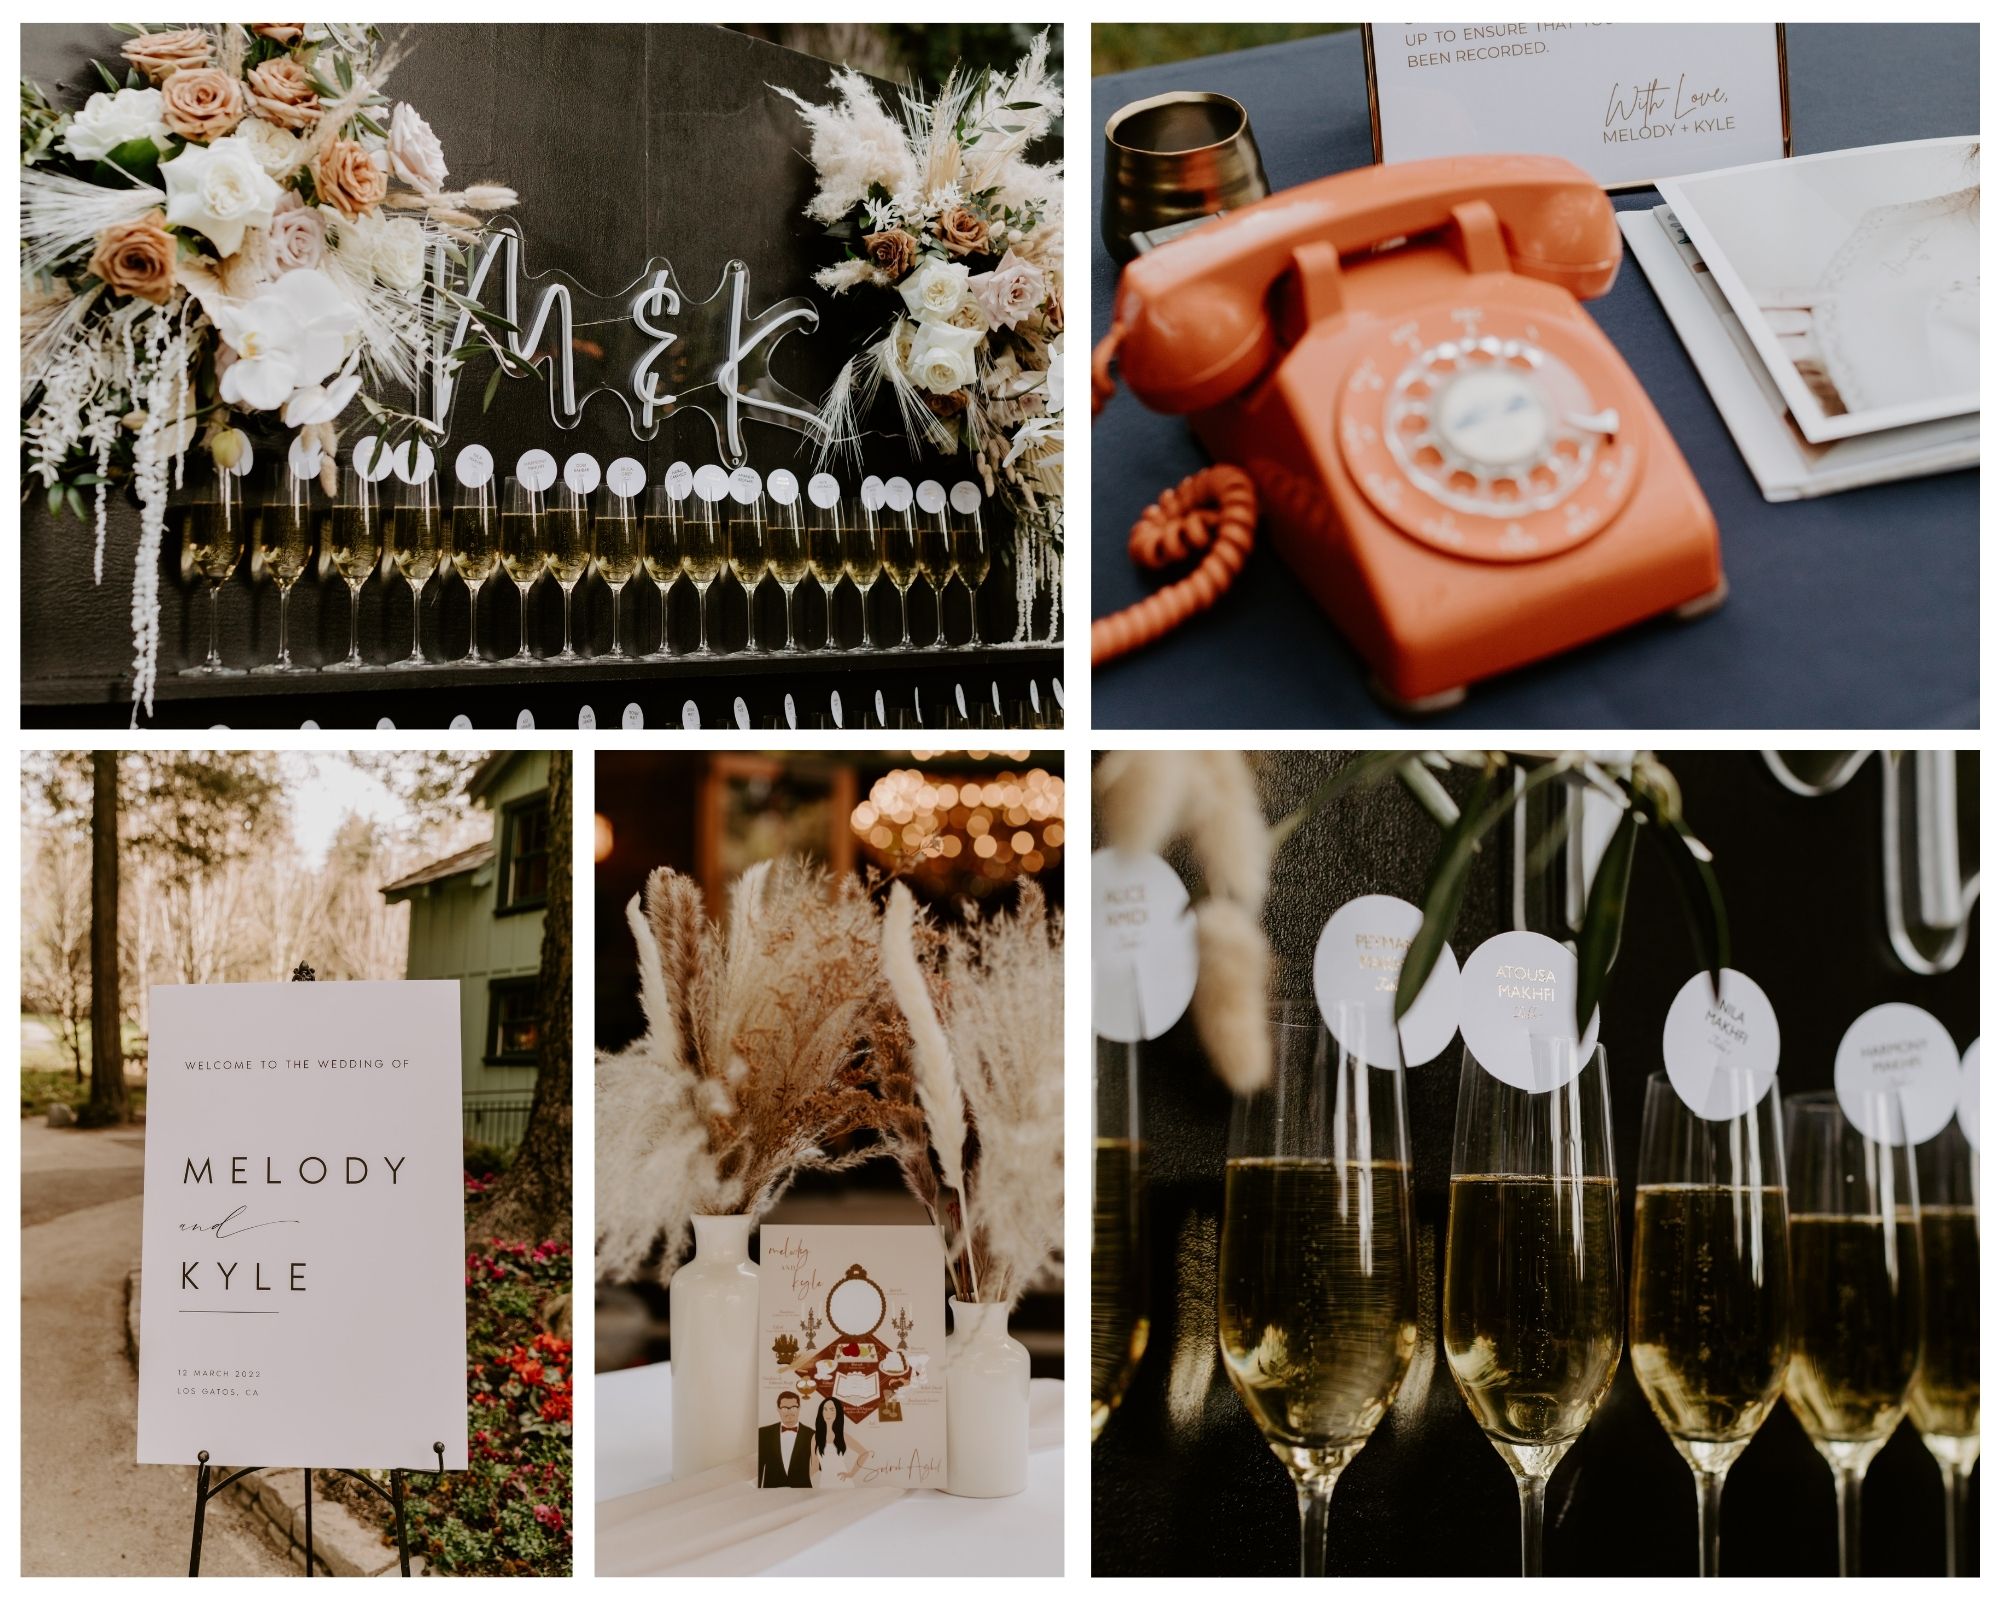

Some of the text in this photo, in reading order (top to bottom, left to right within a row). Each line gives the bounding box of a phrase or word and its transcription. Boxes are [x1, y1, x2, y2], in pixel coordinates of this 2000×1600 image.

[1405, 33, 1428, 47] UP
[1434, 29, 1457, 44] TO
[1463, 22, 1528, 41] ENSURE
[1407, 41, 1550, 68] BEEN RECORDED.
[1605, 73, 1728, 128] With Love,
[1603, 122, 1676, 144] MELODY
[1694, 116, 1735, 133] KYLE
[717, 270, 834, 457] K
[1495, 964, 1557, 984] ATOUSA
[1498, 984, 1555, 1002] MAKHFI
[184, 1059, 409, 1071] WELCOME TO THE WEDDING OF
[184, 1157, 405, 1184] MELODY
[178, 1204, 300, 1239] and
[182, 1262, 306, 1291] KYLE
[177, 1368, 188, 1377] 12
[193, 1369, 229, 1378] MARCH
[177, 1387, 260, 1397] LOS GATOS, CA
